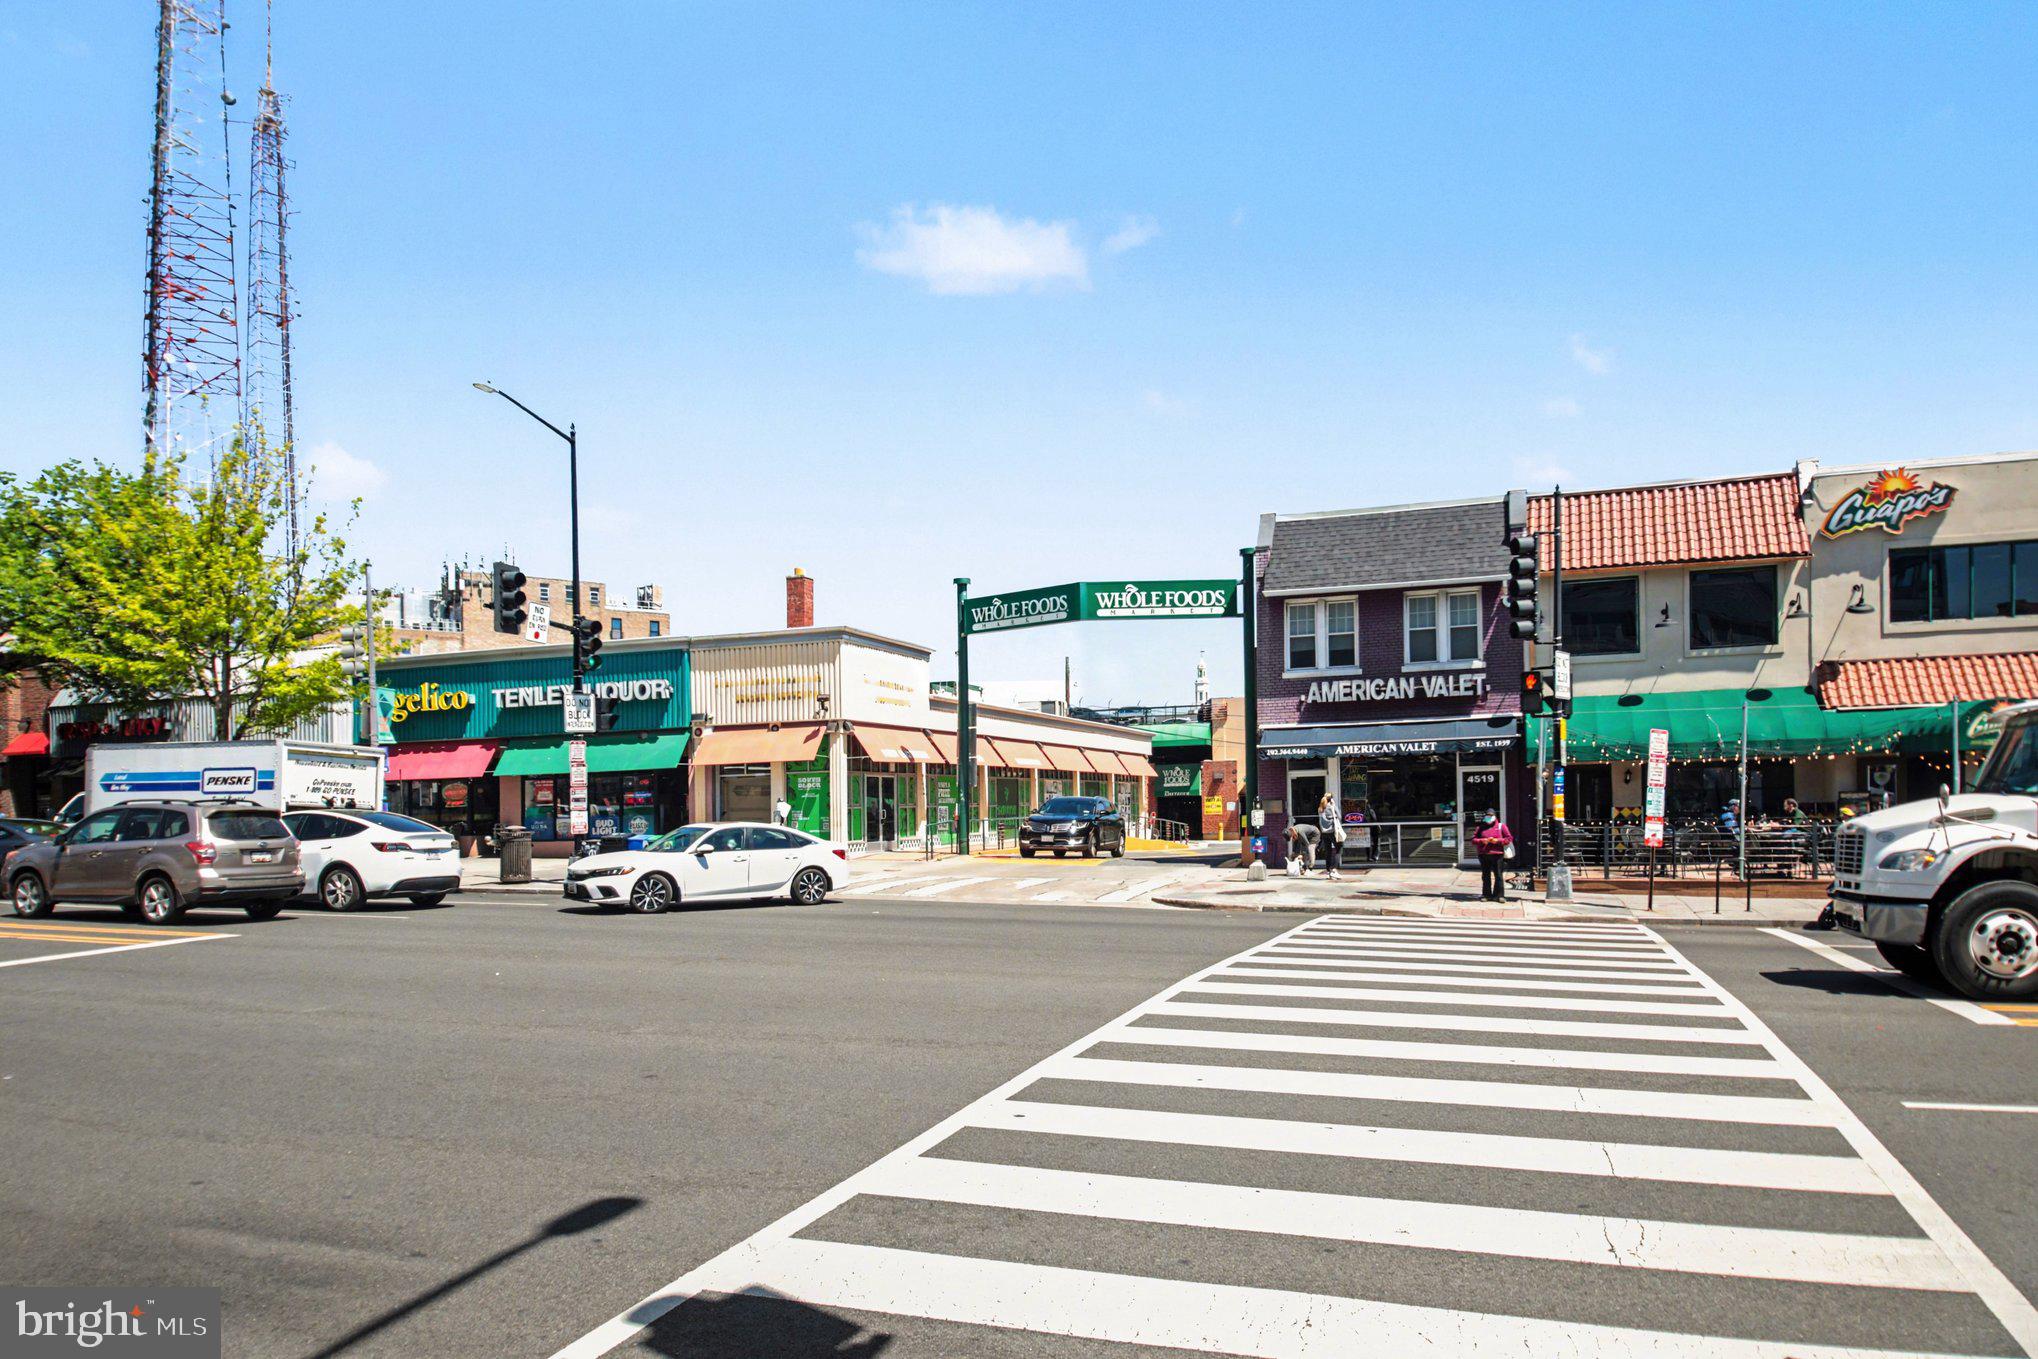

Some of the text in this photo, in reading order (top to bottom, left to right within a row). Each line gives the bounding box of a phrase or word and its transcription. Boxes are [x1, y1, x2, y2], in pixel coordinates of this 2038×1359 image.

[1829, 487, 1950, 533] Guapo's
[1095, 585, 1225, 609] WHOLE FOODS
[534, 606, 545, 615] NO
[971, 595, 1068, 623] WHOLE FOODS
[1306, 673, 1487, 704] AMERICAN VALET
[491, 684, 575, 708] TENLEY
[566, 698, 592, 708] DO NO
[568, 709, 591, 720] BLOCK
[1334, 742, 1437, 755] AMERICAN VALET
[206, 775, 252, 786] PENSKE
[1467, 775, 1495, 783] 4519
[595, 819, 614, 828] BUD
[592, 827, 617, 836] LIGHT
